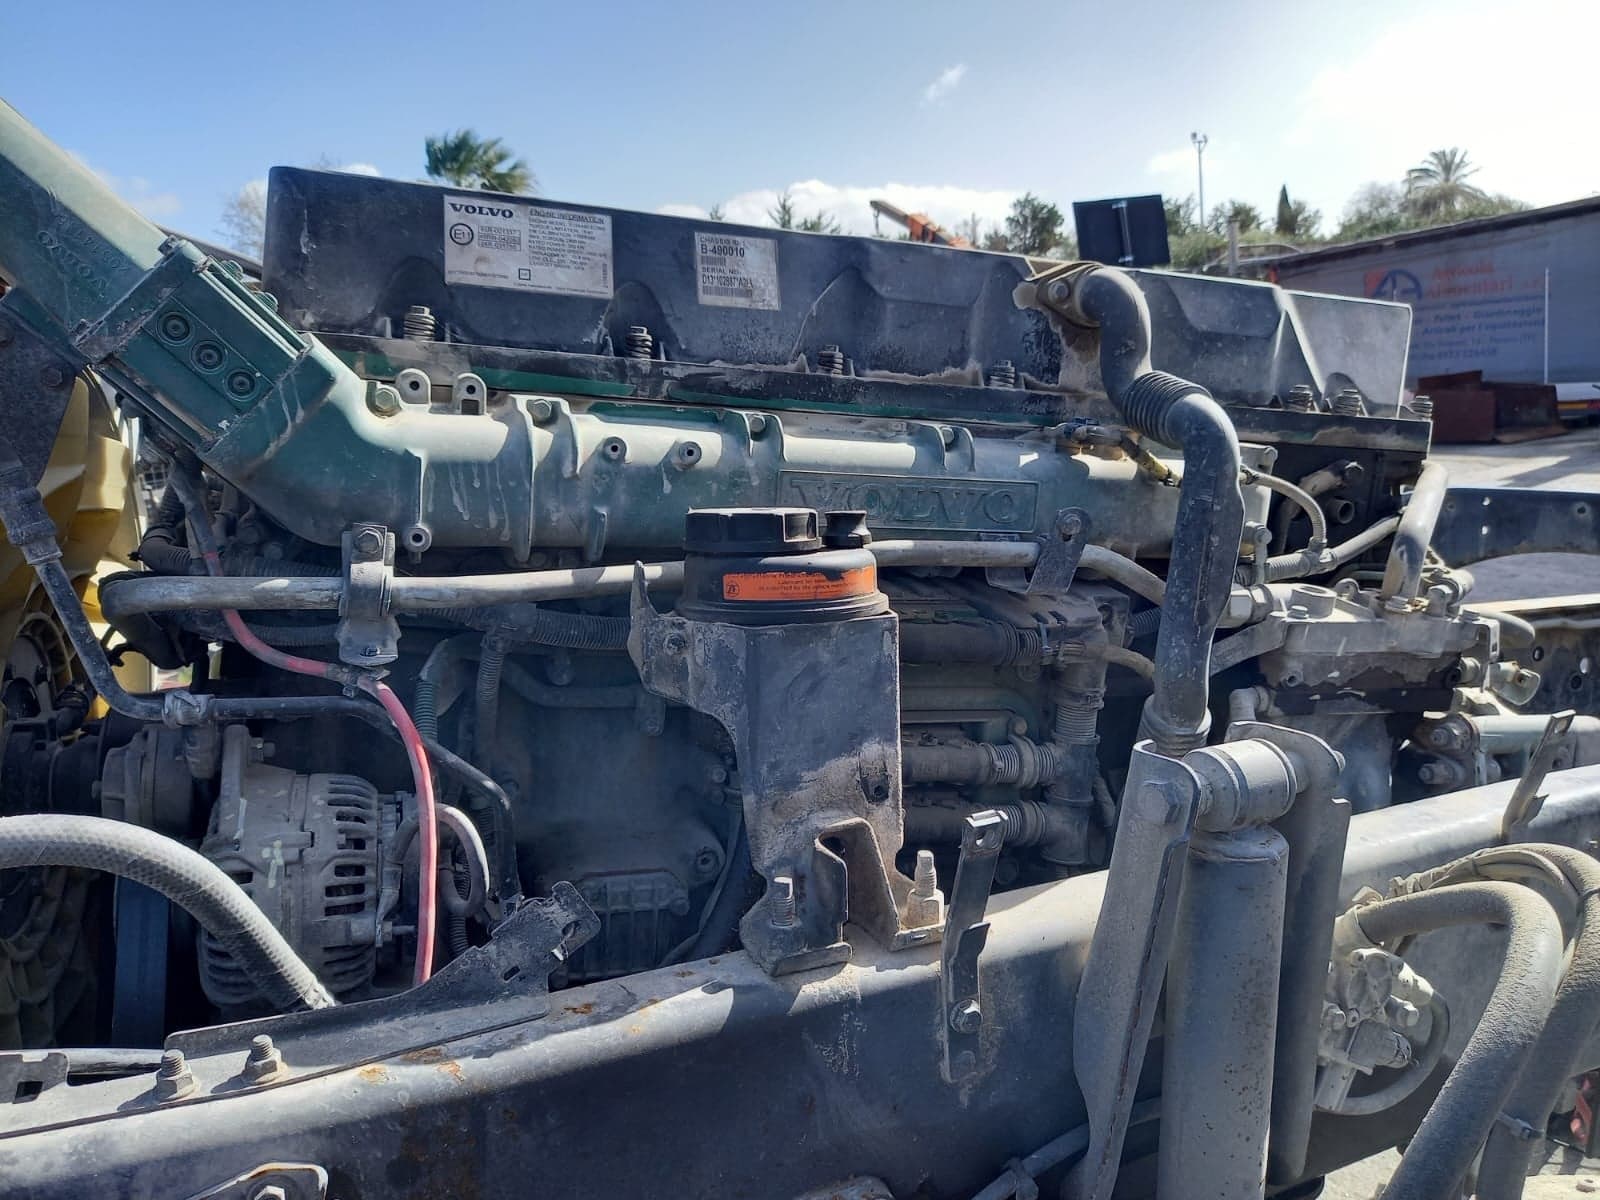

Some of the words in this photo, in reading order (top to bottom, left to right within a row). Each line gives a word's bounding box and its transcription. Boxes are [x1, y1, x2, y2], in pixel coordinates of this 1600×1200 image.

[448, 202, 514, 219] VOLVO
[530, 207, 555, 218] ENGINE
[557, 212, 605, 225] INFORMATION
[701, 243, 745, 258] B-490010
[790, 479, 1020, 524] VOLVO
